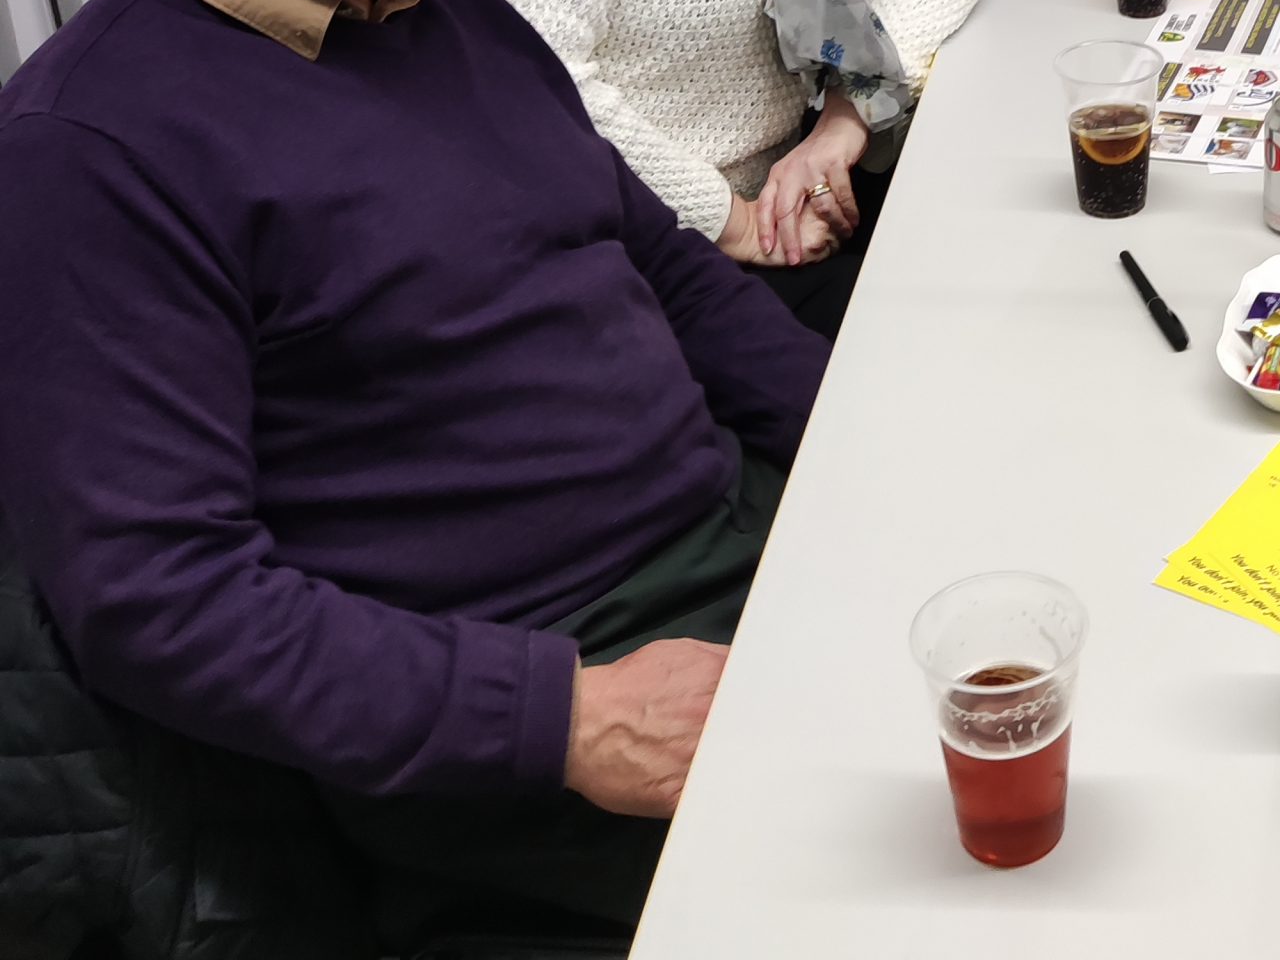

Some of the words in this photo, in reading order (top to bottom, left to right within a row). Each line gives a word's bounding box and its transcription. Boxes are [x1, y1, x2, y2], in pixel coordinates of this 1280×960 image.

[1188, 556, 1205, 570] You
[1231, 553, 1248, 568] You
[1177, 575, 1197, 588] You
